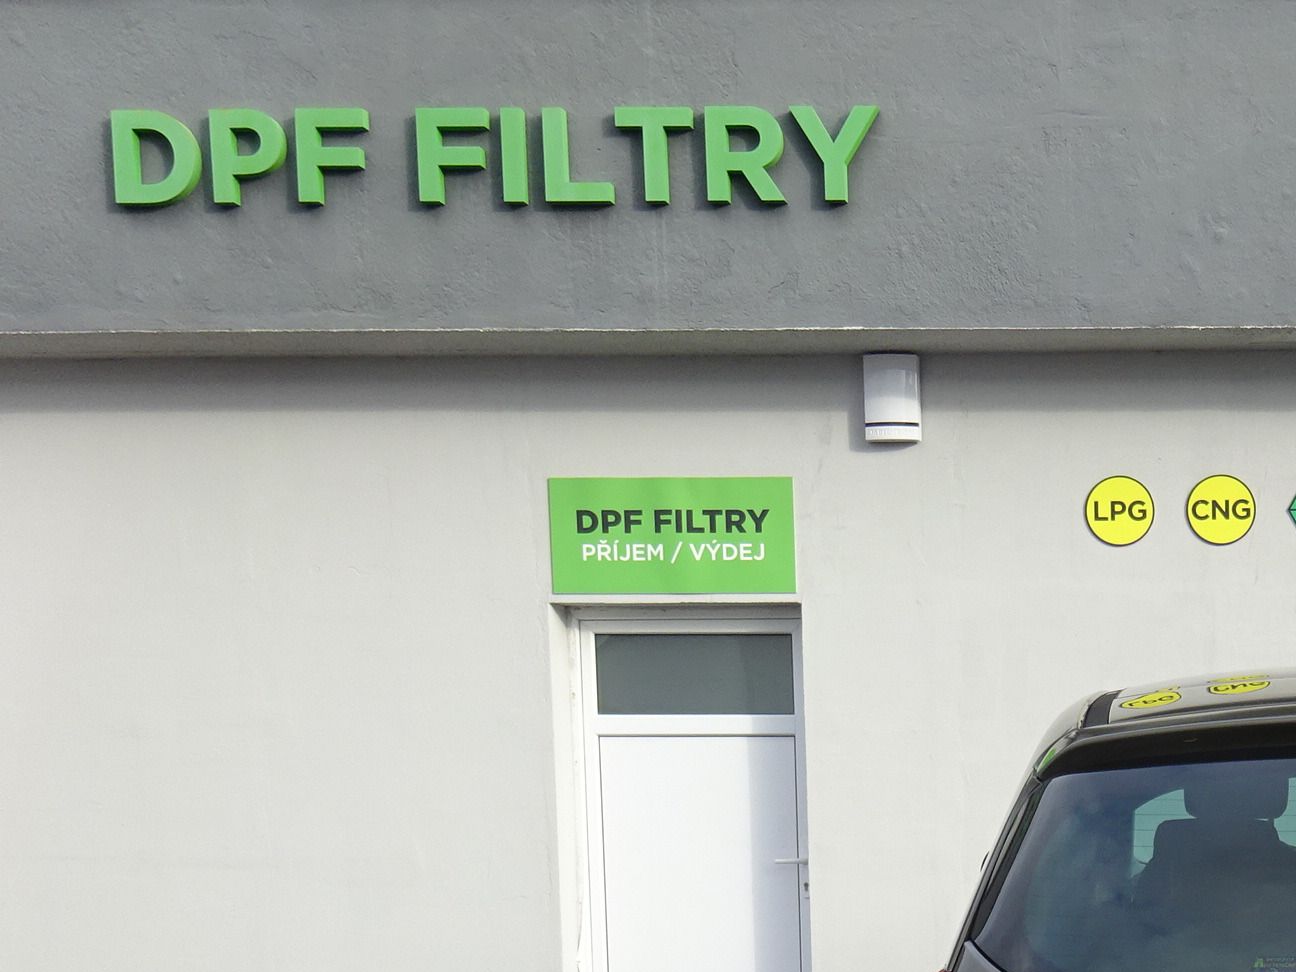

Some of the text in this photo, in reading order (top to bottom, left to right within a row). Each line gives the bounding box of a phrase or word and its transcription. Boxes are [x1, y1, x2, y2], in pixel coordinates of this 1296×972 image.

[110, 104, 879, 207] DPF FILTRY
[575, 509, 770, 534] DPF FILTRY
[1093, 500, 1148, 521] LPG
[1191, 499, 1251, 521] CNG
[582, 539, 664, 562] PŘÍJEM
[689, 539, 766, 562] VÝDEJ
